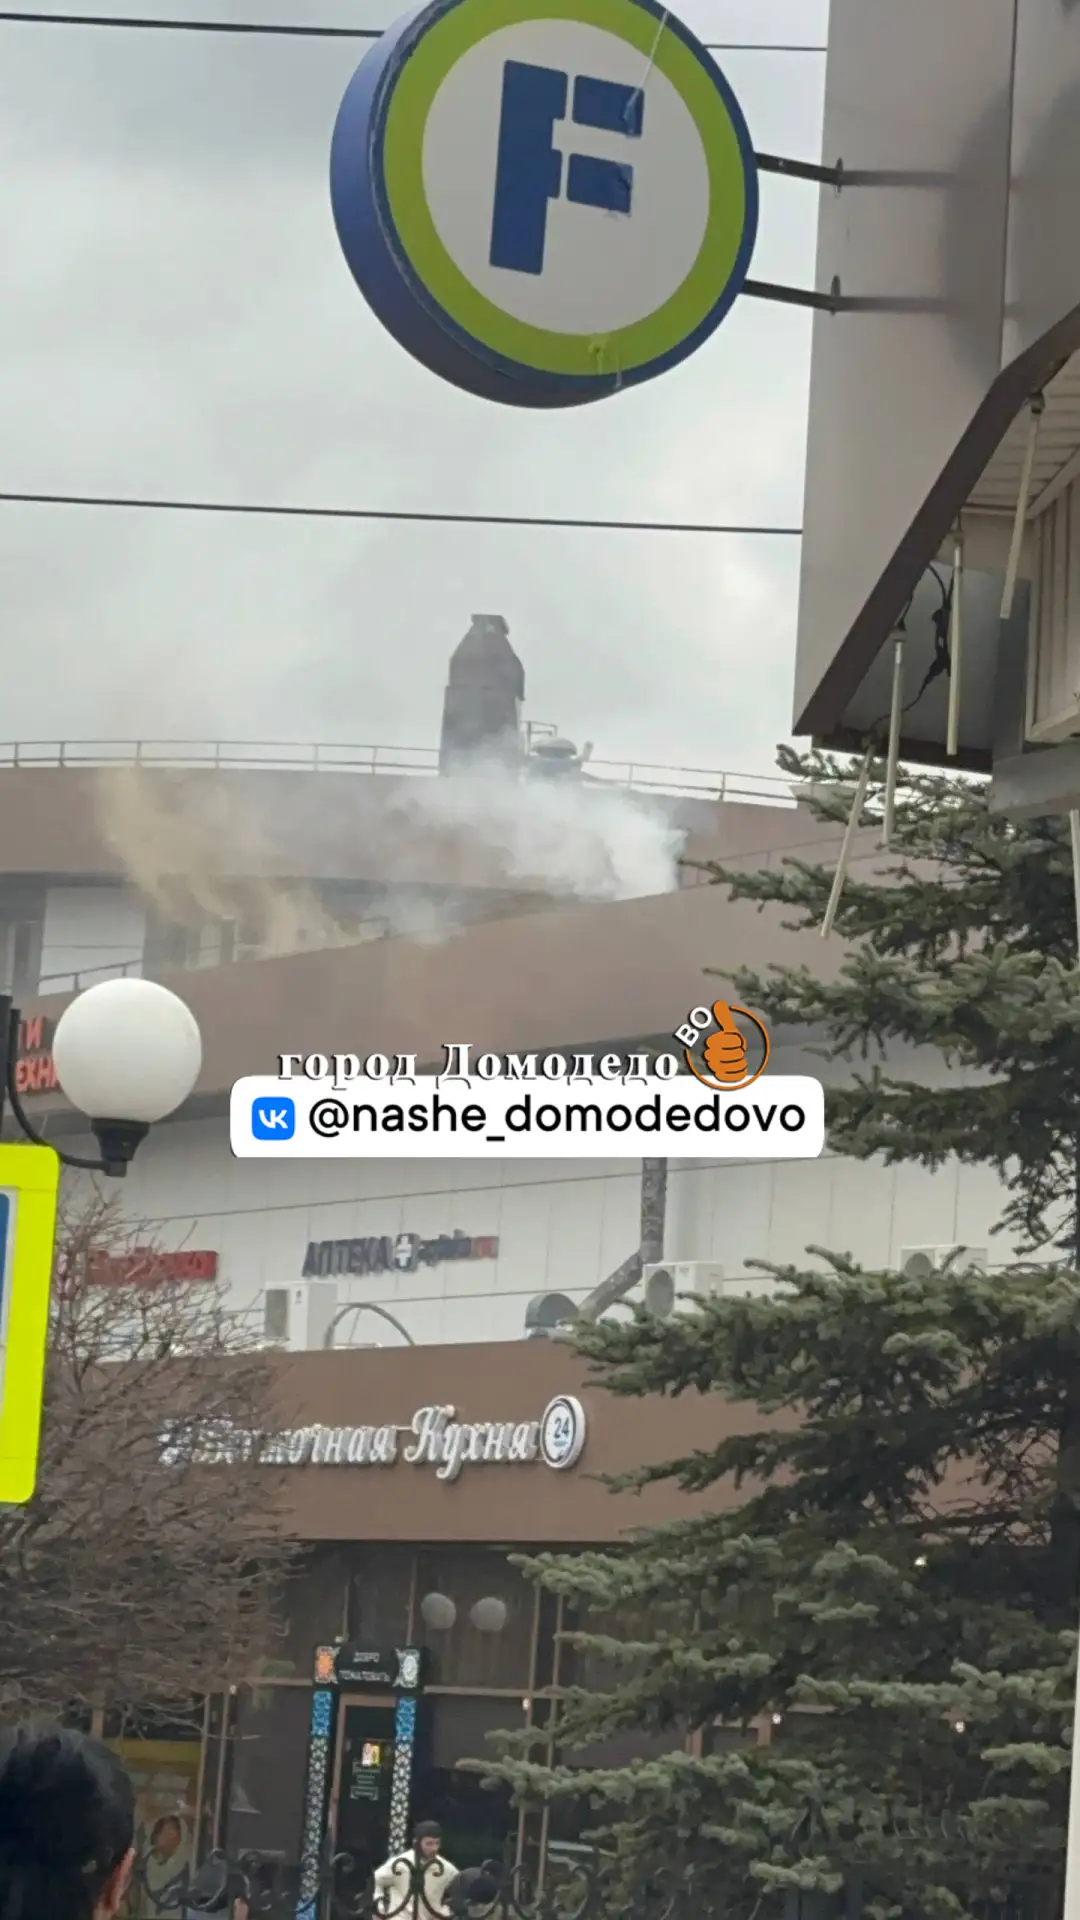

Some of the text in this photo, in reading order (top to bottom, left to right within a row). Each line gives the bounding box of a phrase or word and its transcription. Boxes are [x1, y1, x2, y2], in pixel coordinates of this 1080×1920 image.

[489, 60, 645, 275] F
[302, 1236, 393, 1278] АПТЕКА
[404, 1404, 540, 1480] Кухня
[554, 1416, 570, 1439] 24
